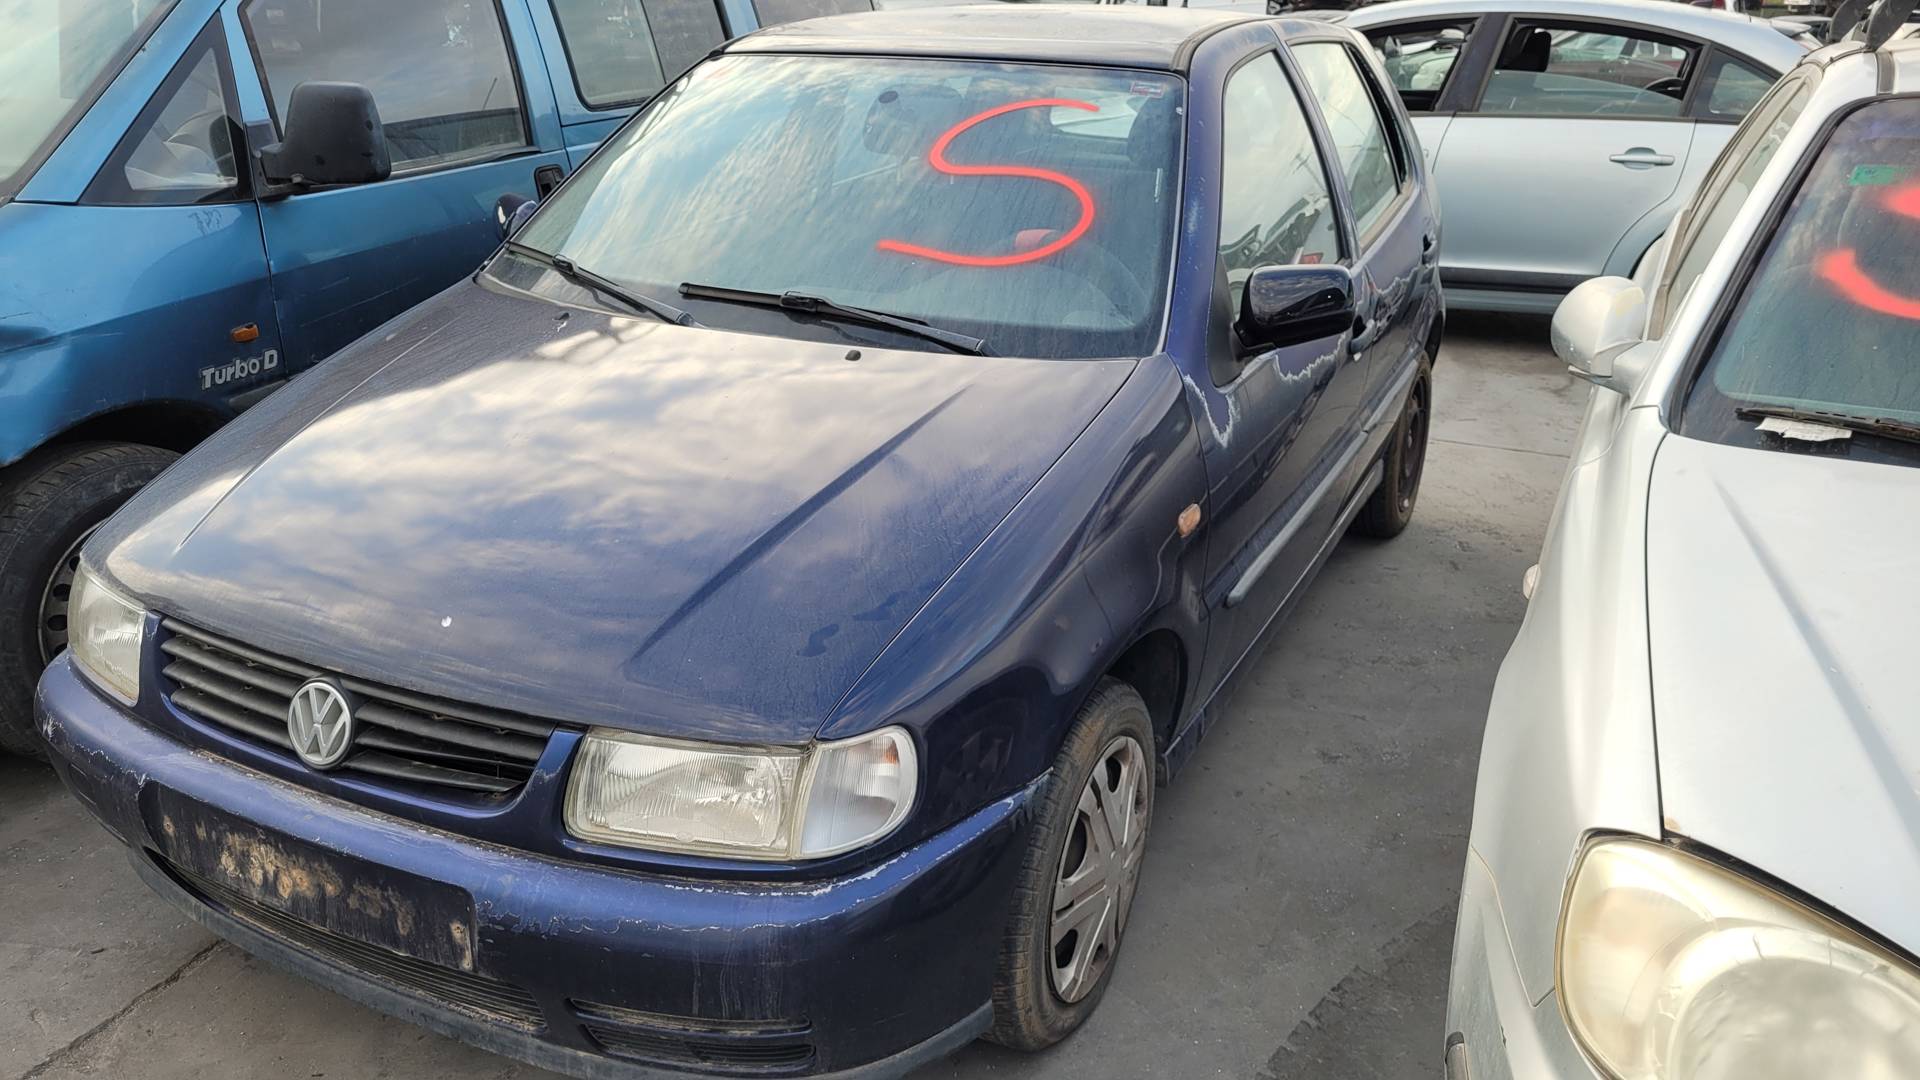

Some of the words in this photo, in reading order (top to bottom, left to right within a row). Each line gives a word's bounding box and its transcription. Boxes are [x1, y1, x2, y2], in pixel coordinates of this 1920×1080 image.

[877, 98, 1099, 266] S
[201, 359, 260, 389] Turbo
[264, 349, 278, 370] D
[288, 682, 351, 765] VW
